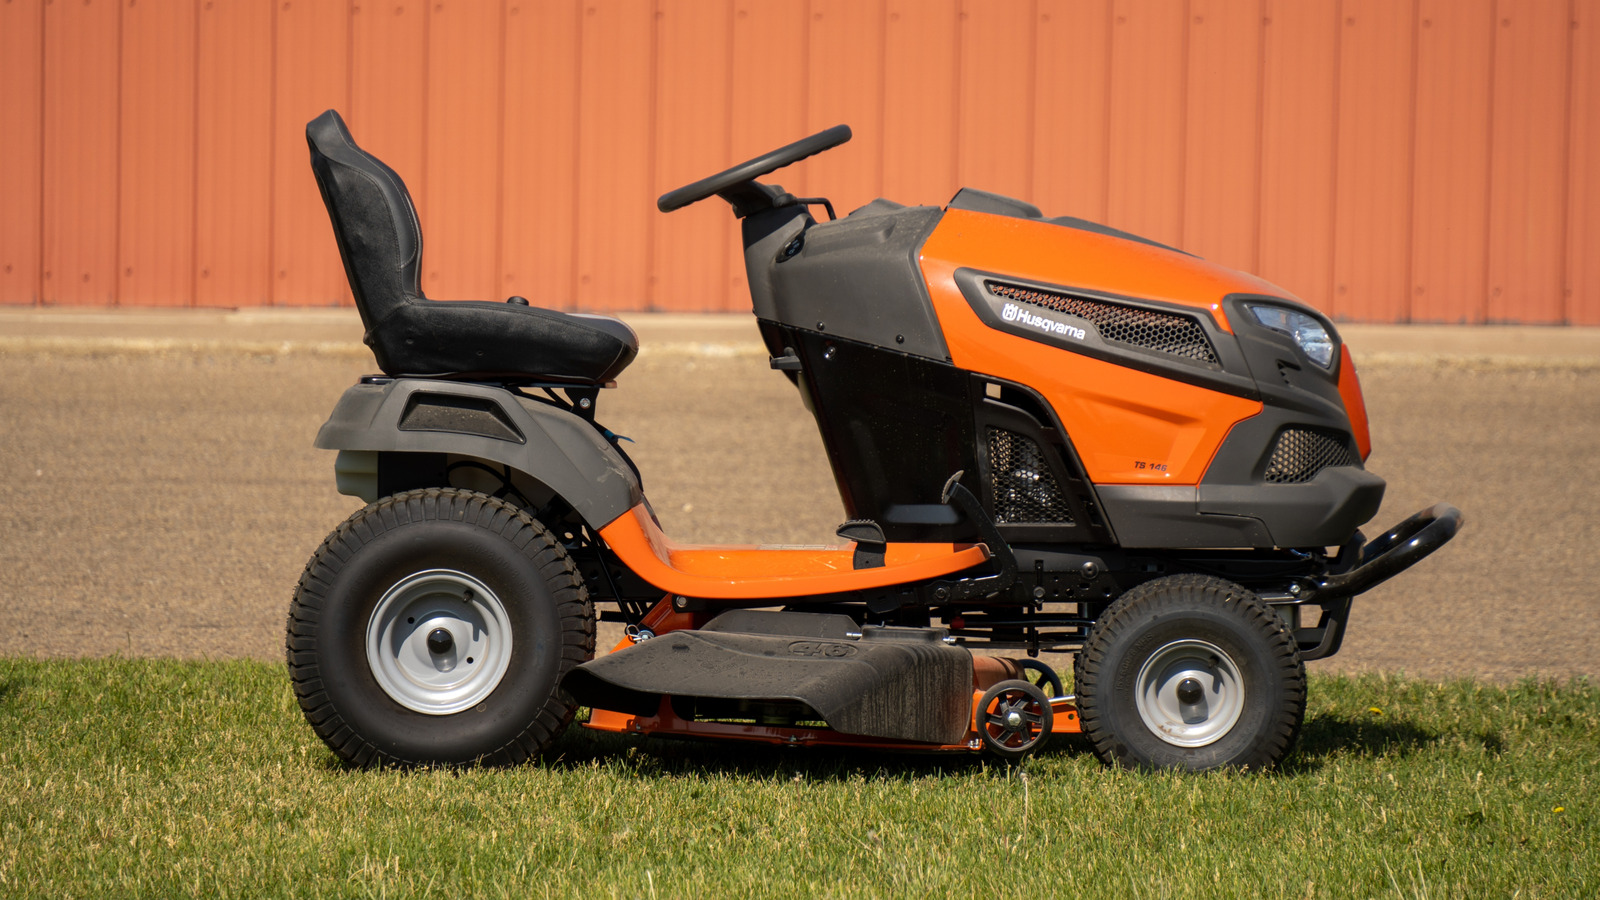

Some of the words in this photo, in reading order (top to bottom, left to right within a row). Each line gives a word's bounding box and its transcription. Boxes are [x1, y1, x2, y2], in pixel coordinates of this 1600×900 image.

[1016, 309, 1086, 340] Husqvarna
[1134, 460, 1146, 469] TS
[1149, 463, 1168, 472] 146
[793, 641, 848, 657] 46
